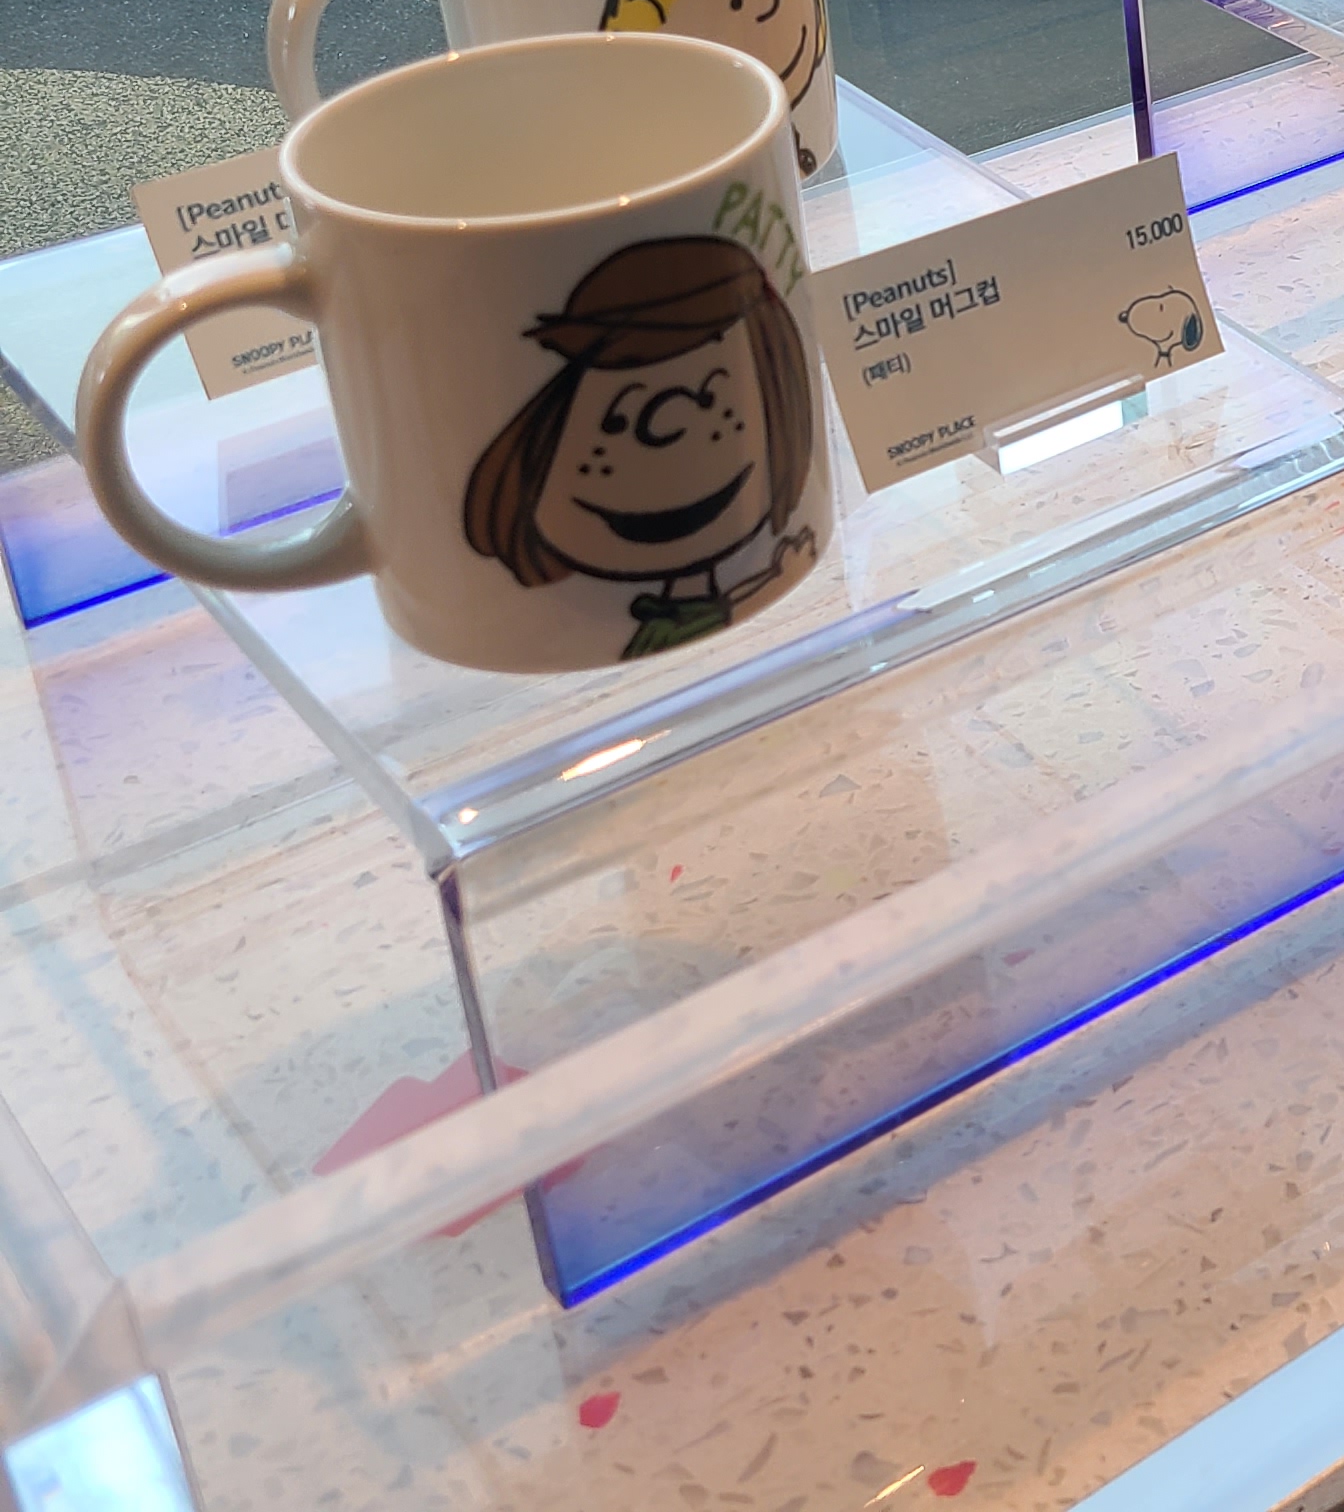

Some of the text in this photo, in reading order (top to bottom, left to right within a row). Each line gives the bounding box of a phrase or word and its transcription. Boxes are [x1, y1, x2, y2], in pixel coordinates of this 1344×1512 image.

[191, 214, 273, 261] 스마일
[711, 180, 804, 298] PATTY
[1125, 212, 1184, 250] 15,000
[843, 259, 958, 322] [Peanuts]
[853, 276, 1002, 351] 스마일 머그컵
[231, 338, 286, 369] SNOOPY
[862, 351, 912, 388] (패티)
[887, 431, 935, 461] SNOOPY
[937, 415, 976, 439] PLACE
